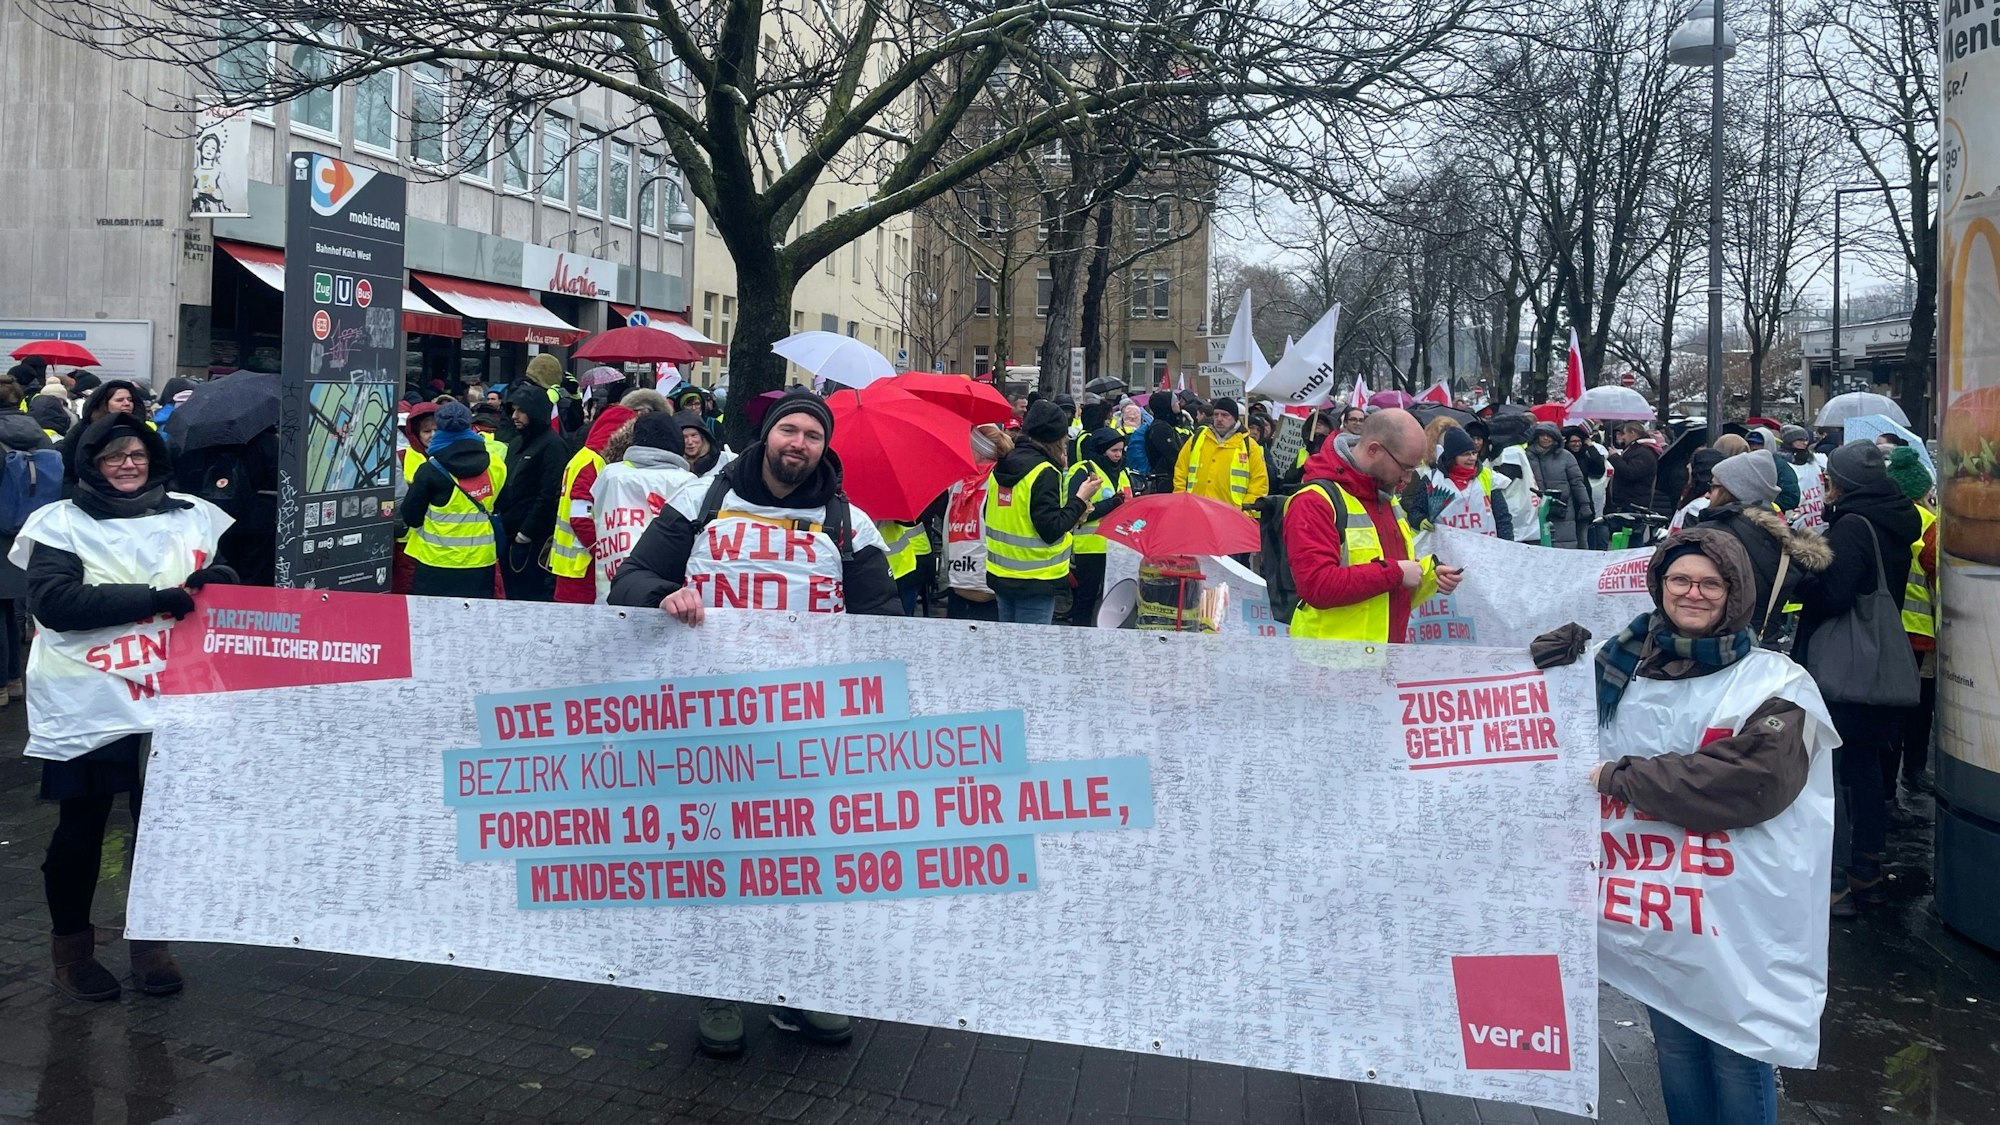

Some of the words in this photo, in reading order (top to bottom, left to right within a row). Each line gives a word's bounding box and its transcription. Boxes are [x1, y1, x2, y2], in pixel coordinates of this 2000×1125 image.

[315, 242, 342, 256] Bahnhof
[342, 247, 356, 259] Köln
[356, 249, 372, 261] West
[316, 282, 331, 297] Zug
[338, 280, 350, 302] U
[549, 253, 598, 298] Maria
[357, 287, 371, 300] Bus
[524, 327, 544, 344] Maria
[1290, 361, 1333, 400] GmbH
[604, 507, 645, 531] WIR
[1441, 512, 1482, 530] WIR
[708, 522, 817, 563] WIR
[683, 572, 788, 611] IND
[1597, 575, 1626, 590] GEHT
[206, 607, 302, 634] TARIFRUNDE
[1419, 598, 1455, 618] ALLE,
[203, 628, 319, 661] ÖFFENTLICHER
[321, 640, 382, 665] DIENST
[1419, 622, 1442, 641] 500
[494, 702, 555, 741] DIE
[564, 680, 826, 736] BESCHÄFTIGTEN
[839, 675, 884, 717] IM
[1399, 680, 1550, 725] ZUSAMMEN
[1405, 725, 1472, 760] GEHT
[1483, 716, 1560, 753] MEHR
[459, 753, 570, 797] BEZIRK
[581, 724, 1003, 790] KÖLN-BONN-LEVERKUSEN
[480, 807, 612, 850] FORDERN
[622, 801, 721, 851] 10,5%
[731, 797, 817, 840] MEHR
[828, 789, 920, 836] GELD
[934, 776, 1004, 828] FÜR
[1018, 776, 1130, 826] ALLE,
[530, 858, 727, 903] MINDESTENS
[739, 855, 823, 898] ABER
[834, 850, 902, 895] 500
[916, 843, 1029, 890] EURO.
[1600, 876, 1719, 937] ERT.
[1467, 1022, 1561, 1055] ver.di
